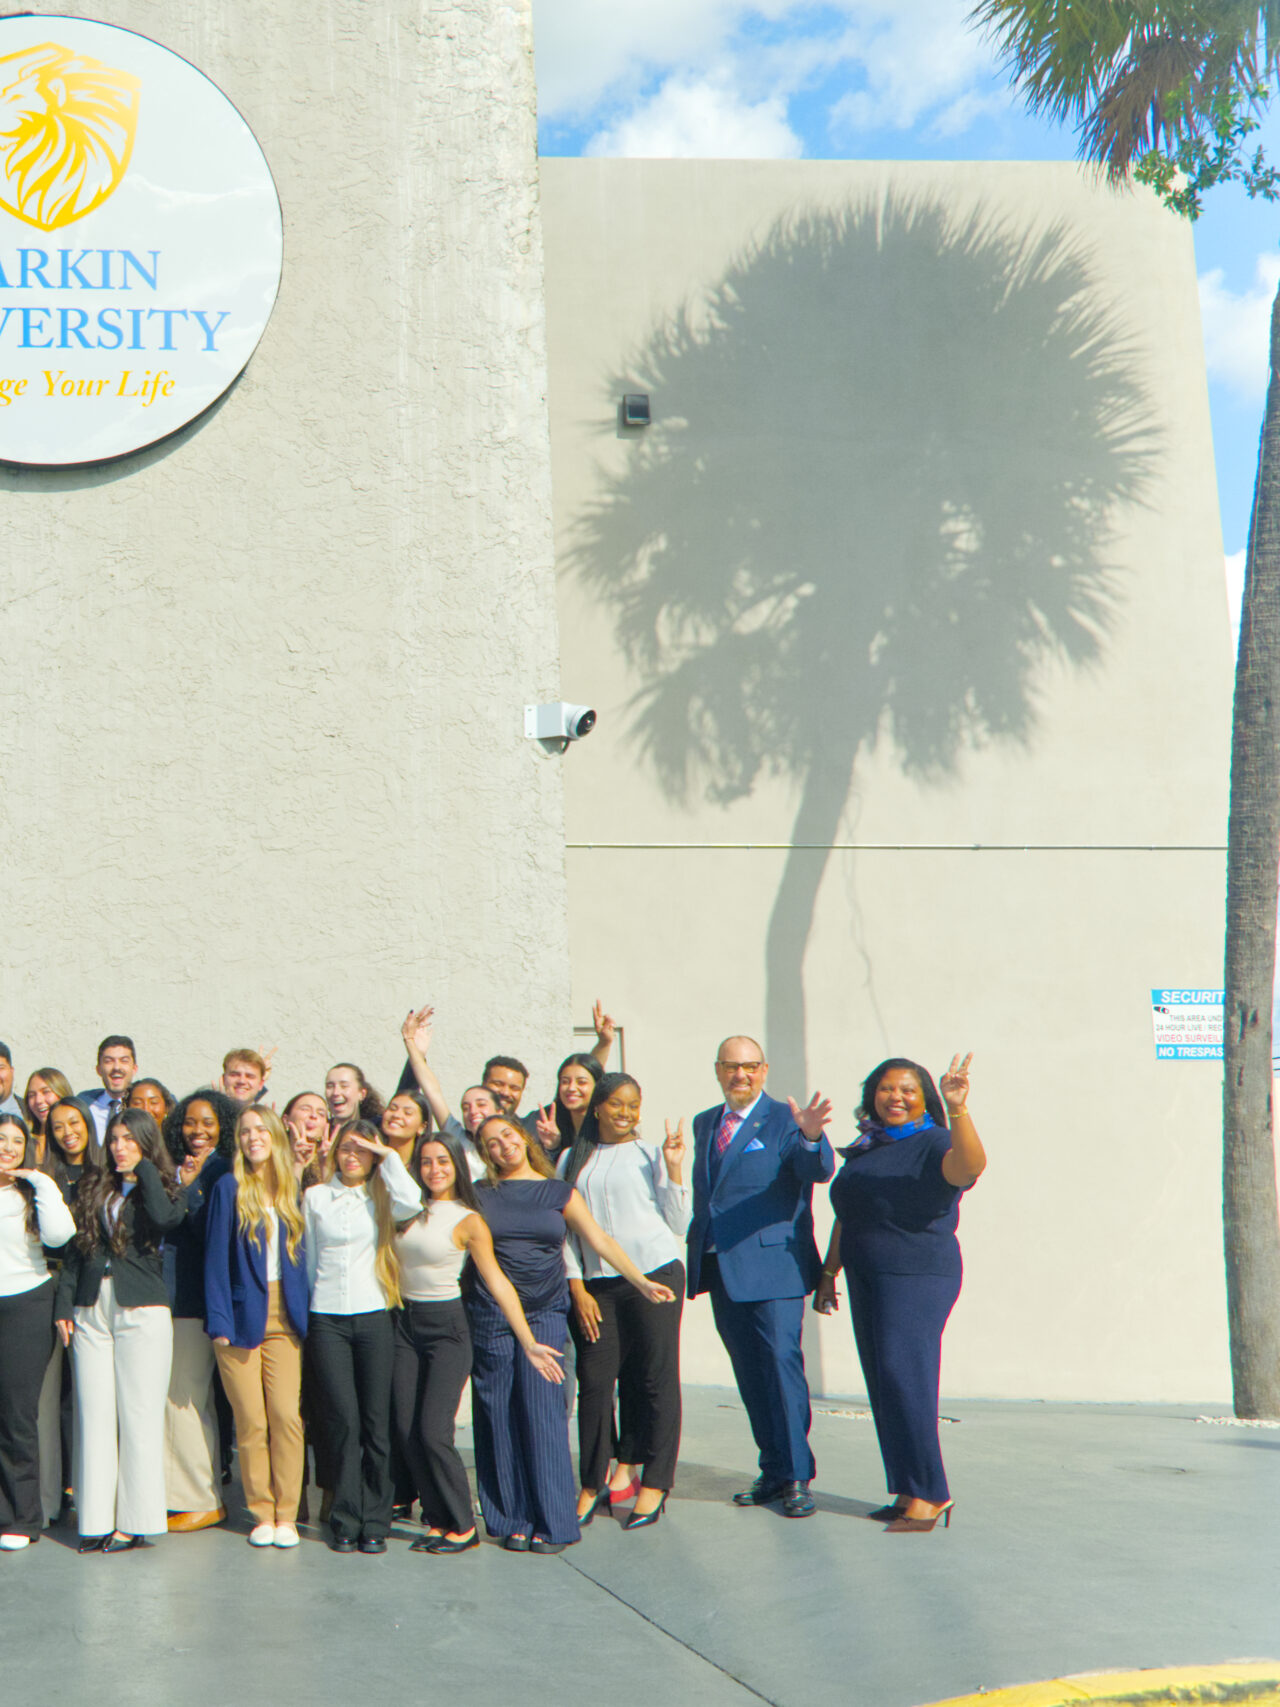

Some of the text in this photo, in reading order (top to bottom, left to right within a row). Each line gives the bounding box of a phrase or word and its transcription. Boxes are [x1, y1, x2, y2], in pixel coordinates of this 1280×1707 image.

[41, 370, 111, 398] Your
[115, 370, 176, 407] Life
[1161, 991, 1224, 1003] SECURIT
[1156, 1034, 1183, 1042] VIDEO
[1159, 1047, 1224, 1056] NO TRESPAS
